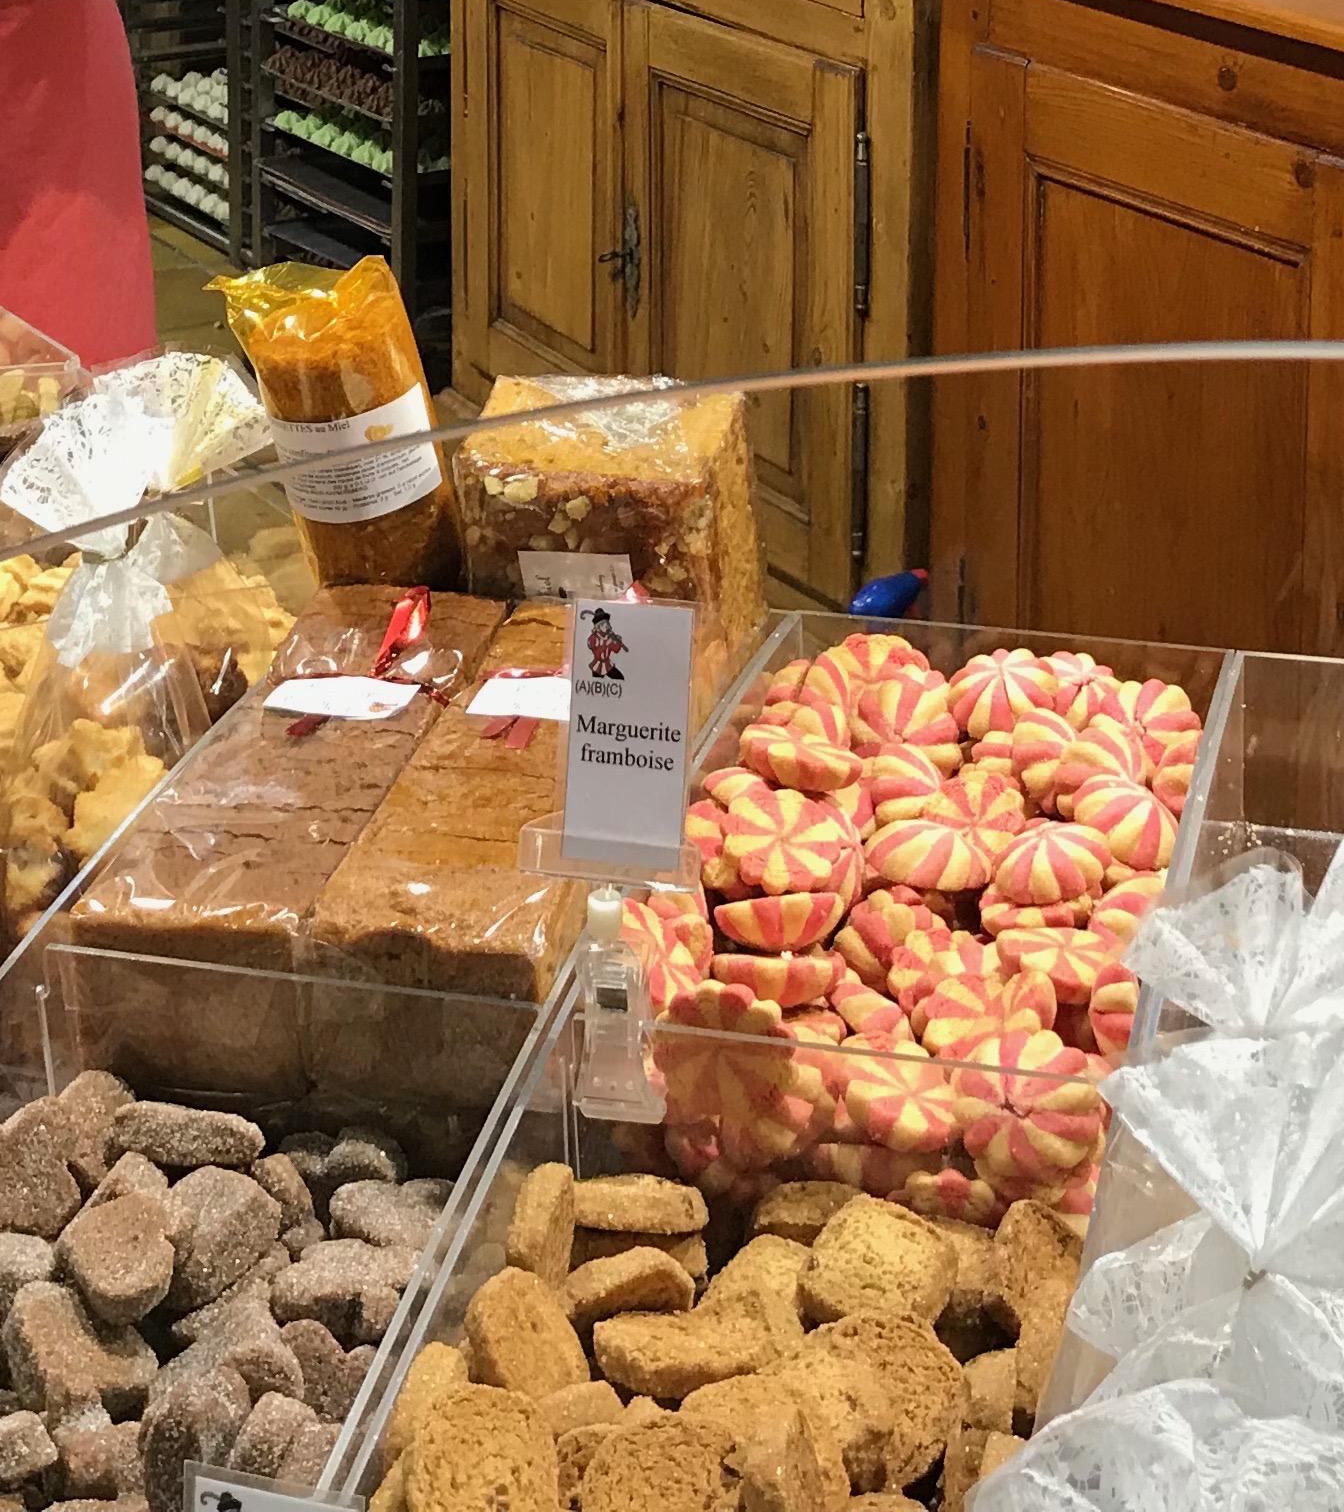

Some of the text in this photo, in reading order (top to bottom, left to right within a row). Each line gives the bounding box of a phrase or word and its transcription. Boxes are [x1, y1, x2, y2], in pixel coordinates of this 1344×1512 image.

[315, 425, 327, 433] au
[328, 419, 350, 432] Miel
[575, 679, 623, 699] (A)(B)(C)
[576, 714, 682, 743] Marguerite
[580, 743, 674, 772] framboise
